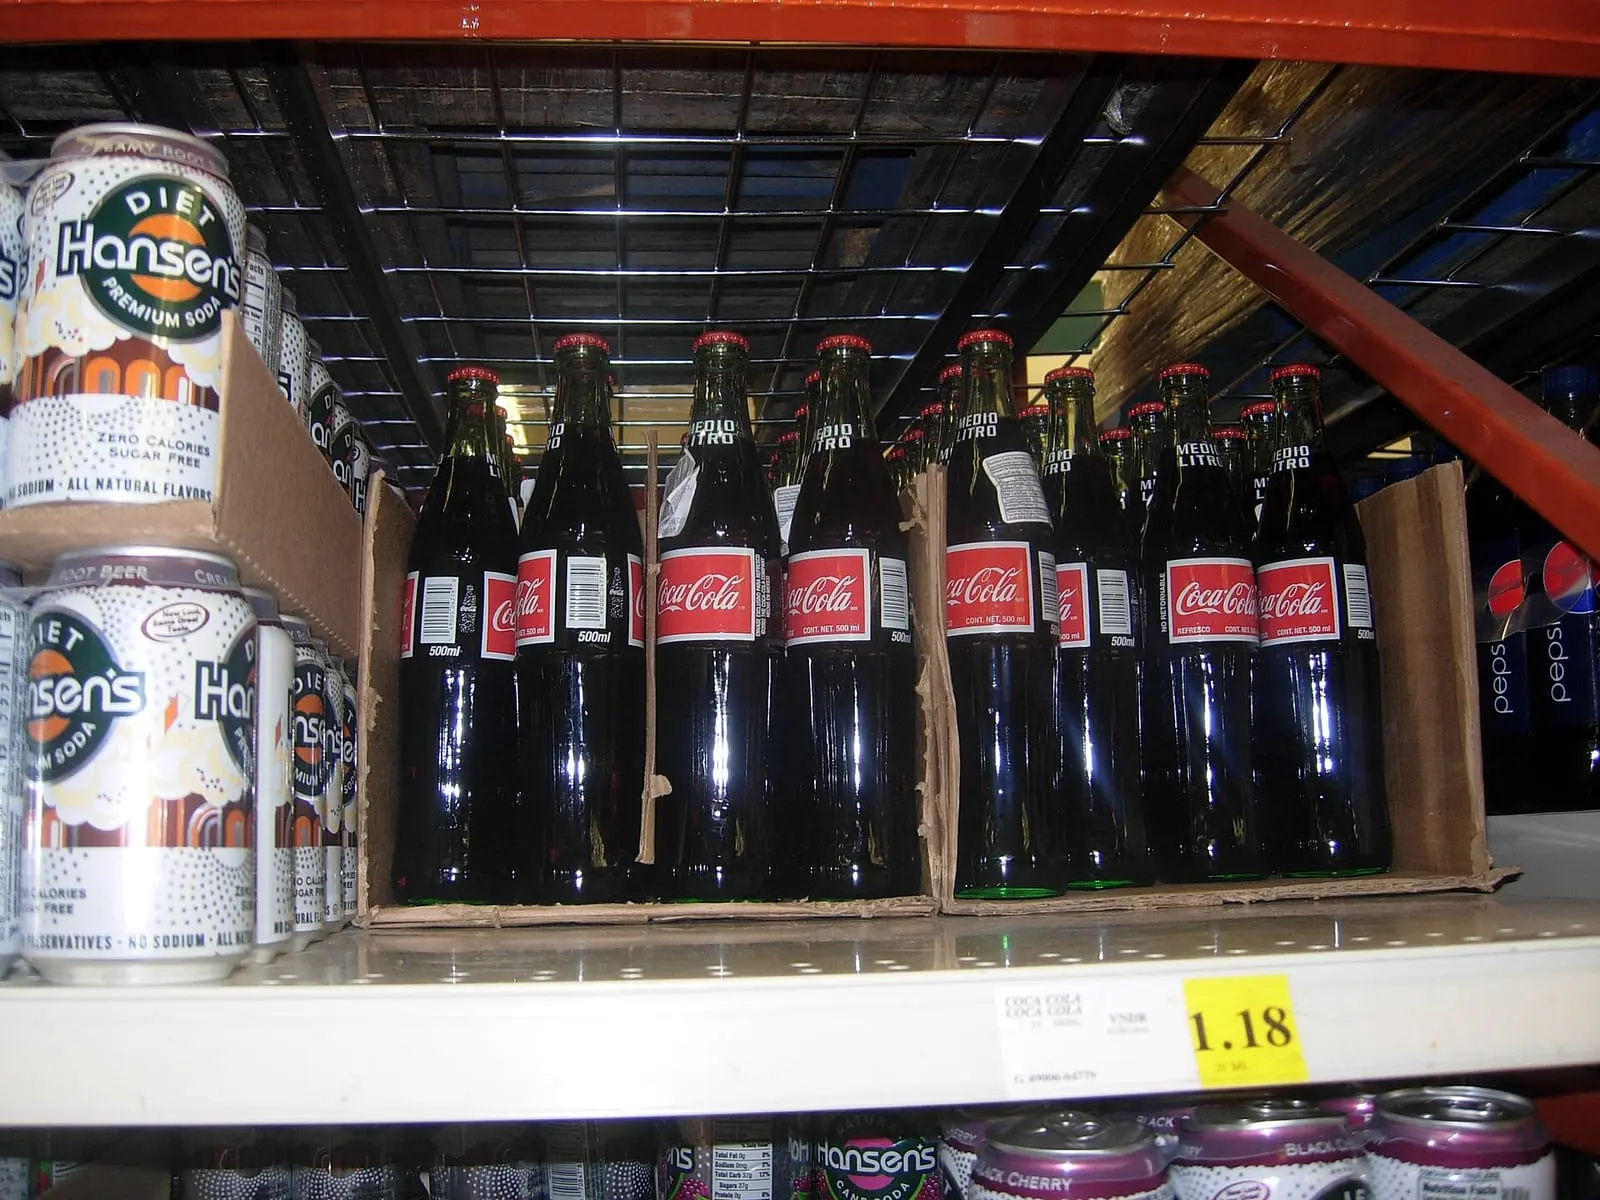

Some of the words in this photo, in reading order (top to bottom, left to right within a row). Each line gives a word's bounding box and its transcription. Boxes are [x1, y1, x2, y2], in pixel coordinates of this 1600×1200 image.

[125, 186, 215, 225] DIET
[61, 220, 241, 300] Hansen's
[249, 263, 264, 276] acts
[102, 276, 182, 329] PREMIUM
[184, 296, 222, 328] SODA
[691, 419, 735, 434] EDIO
[958, 412, 998, 430] MEDIO
[690, 432, 734, 447] ITRO
[816, 423, 853, 440] EDIO
[956, 425, 997, 443] LITRO
[97, 432, 140, 445] ZERO
[146, 435, 211, 457] CALORIES
[812, 436, 851, 454] ITRO
[109, 448, 161, 461] SUGAR
[168, 454, 201, 469] FREE
[1048, 448, 1073, 464] DIO
[1272, 456, 1310, 473] ITRO
[1044, 460, 1071, 477] TRO
[17, 479, 55, 498] SODIUM
[67, 477, 89, 491] ALL
[96, 477, 159, 494] NATURAL
[163, 482, 213, 504] FLAVORS
[101, 564, 149, 580] BEER
[946, 567, 1023, 604] ca-Cola
[785, 575, 857, 617] ca-Cola
[1159, 572, 1167, 621] RETORNABLE
[1259, 581, 1327, 618] ca-Cola
[965, 617, 985, 625] CONT.
[985, 616, 1001, 624] NET.
[1002, 616, 1015, 624] 500
[1016, 615, 1026, 624] ml
[1160, 621, 1168, 633] NO
[578, 630, 611, 644] 500ml
[803, 625, 820, 635] CONT.
[821, 624, 836, 634] NET.
[836, 624, 850, 633] 500
[851, 624, 860, 632] ml
[1177, 625, 1211, 634] REFRESCO
[1277, 628, 1293, 636] CONT.
[1309, 626, 1321, 634] 500
[1322, 625, 1331, 633] ml
[1111, 636, 1135, 647] 500ml
[429, 645, 461, 657] 500ml
[1547, 621, 1572, 702] pepsi
[293, 671, 322, 694] DIE
[1491, 643, 1514, 714] peps
[28, 667, 142, 717] nsen's
[54, 720, 97, 764] SODA
[294, 767, 319, 786] MIUM
[292, 888, 314, 898] UGAR
[44, 902, 75, 915] FREE
[295, 912, 313, 924] URAL
[153, 932, 205, 949] SODIUM
[216, 932, 233, 946] ALL
[1005, 996, 1041, 1008] COCA
[1046, 993, 1081, 1005] COLA
[1006, 1006, 1042, 1018] COCA
[1047, 1004, 1083, 1016] COLA
[1189, 1005, 1293, 1052] 1.18
[949, 1127, 977, 1143] ERRY
[817, 1139, 937, 1174] Hansen's
[977, 1162, 1003, 1184] LACK
[1007, 1171, 1073, 1192] CHERRY
